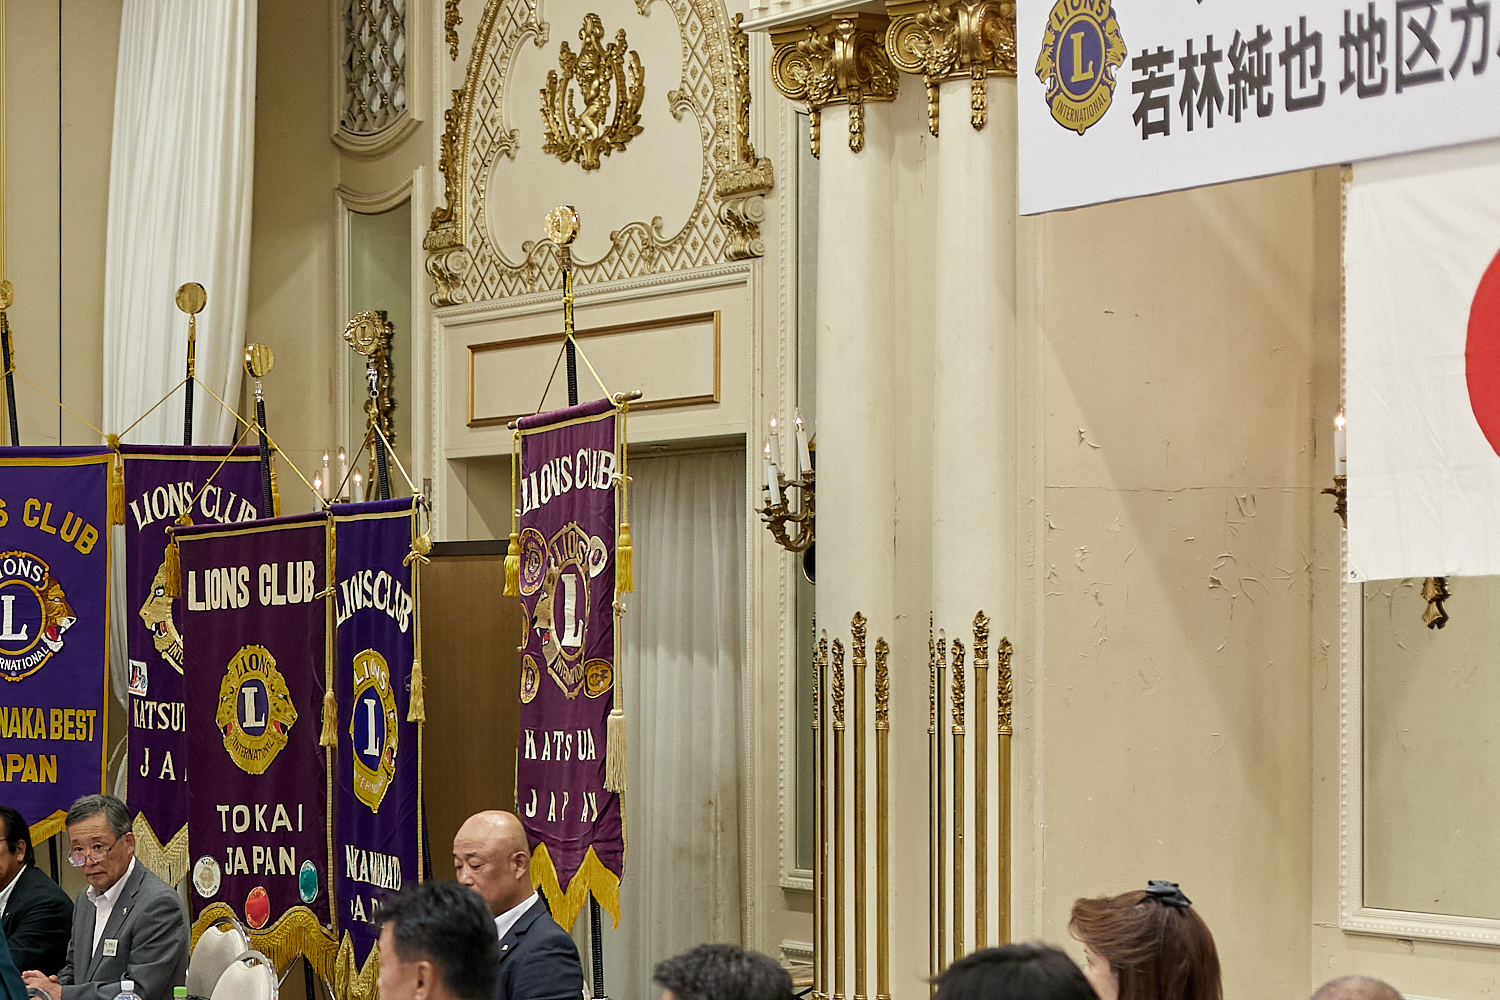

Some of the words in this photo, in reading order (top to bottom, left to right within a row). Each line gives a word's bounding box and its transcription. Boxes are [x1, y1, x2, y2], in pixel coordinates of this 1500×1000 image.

[1071, 32, 1094, 82] L
[1056, 92, 1108, 122] INTERNATIONAL
[129, 481, 194, 531] LIONS
[521, 454, 573, 516] LIONS
[23, 498, 99, 555] CLUB
[188, 566, 249, 611] LIONS
[258, 560, 315, 606] CLUB
[0, 595, 28, 640] L
[561, 573, 583, 648] L
[235, 653, 272, 678] LIONS
[50, 709, 96, 741] BEST
[242, 687, 265, 728] L
[363, 699, 379, 756] L
[217, 804, 303, 833] TOKAI
[225, 846, 296, 876] JAPAN
